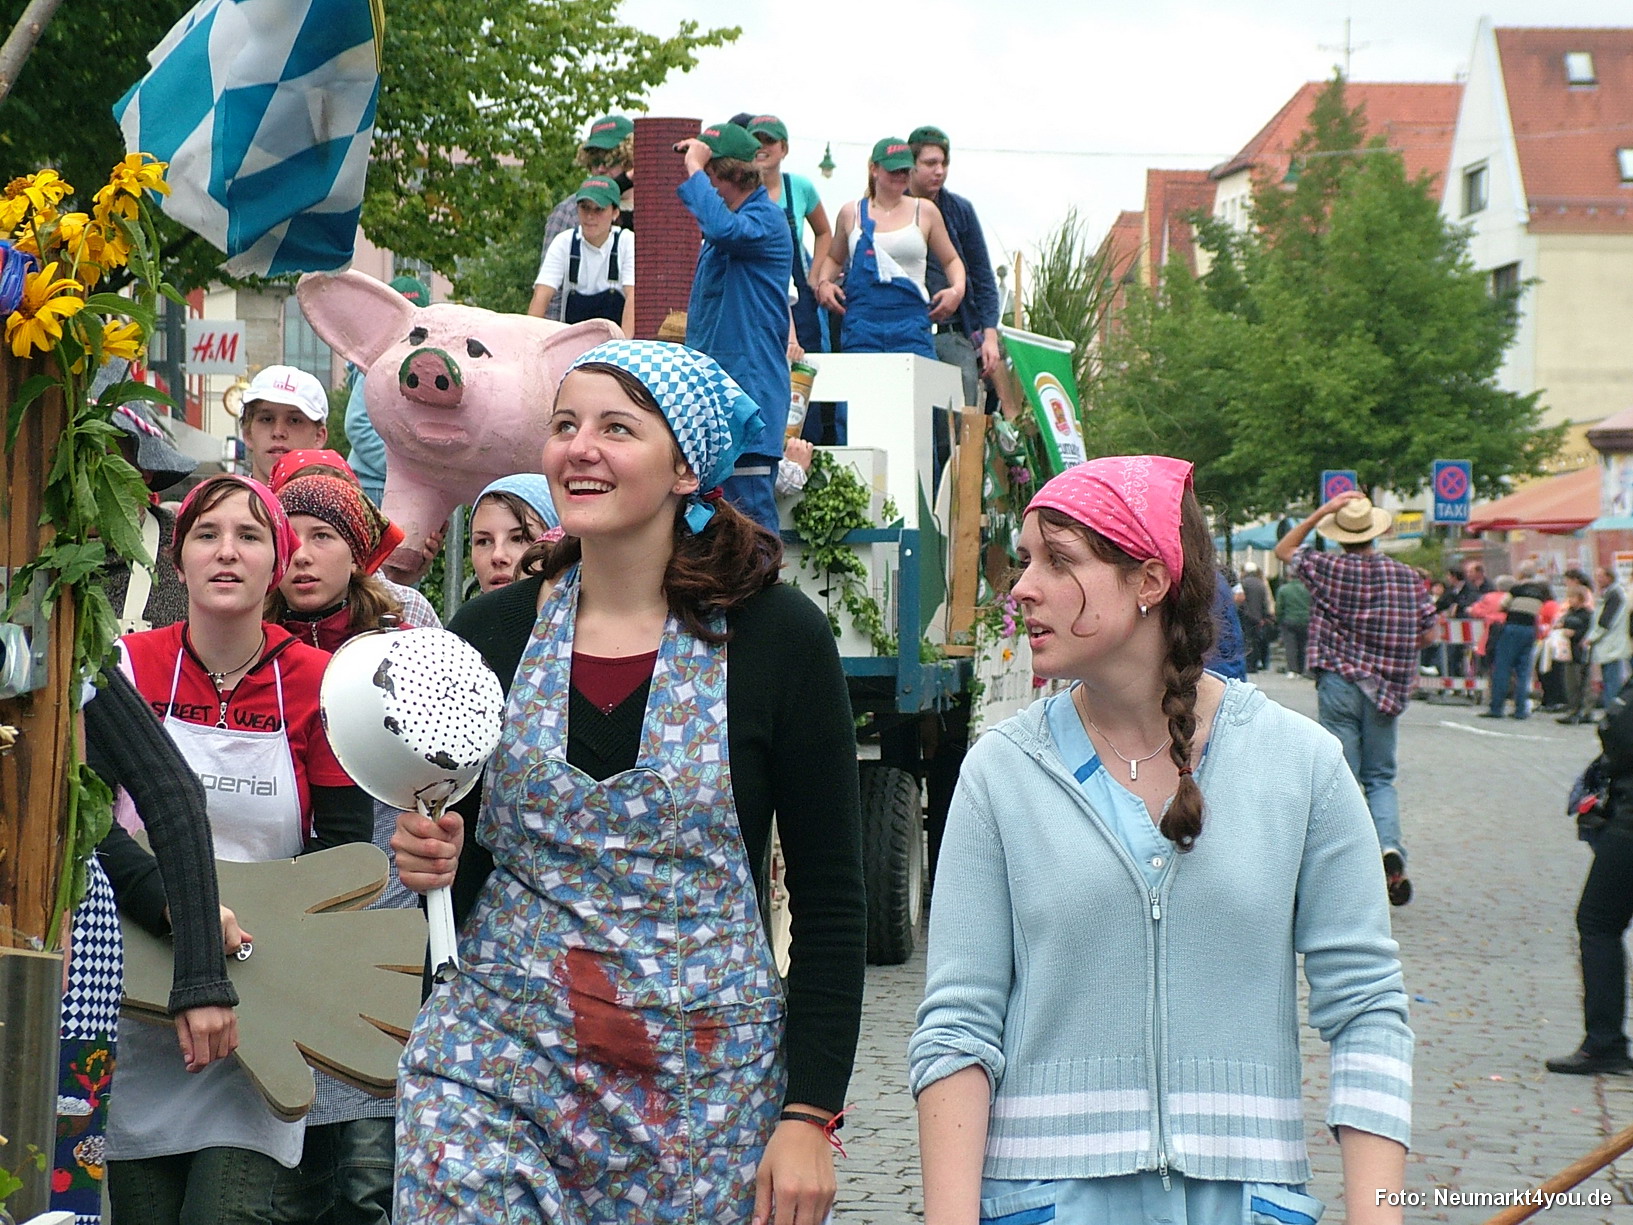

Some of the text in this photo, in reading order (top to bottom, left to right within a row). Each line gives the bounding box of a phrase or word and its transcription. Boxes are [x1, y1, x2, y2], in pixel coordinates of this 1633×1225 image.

[192, 332, 239, 363] H&M
[1437, 502, 1468, 518] TAXI
[200, 773, 278, 796] perial
